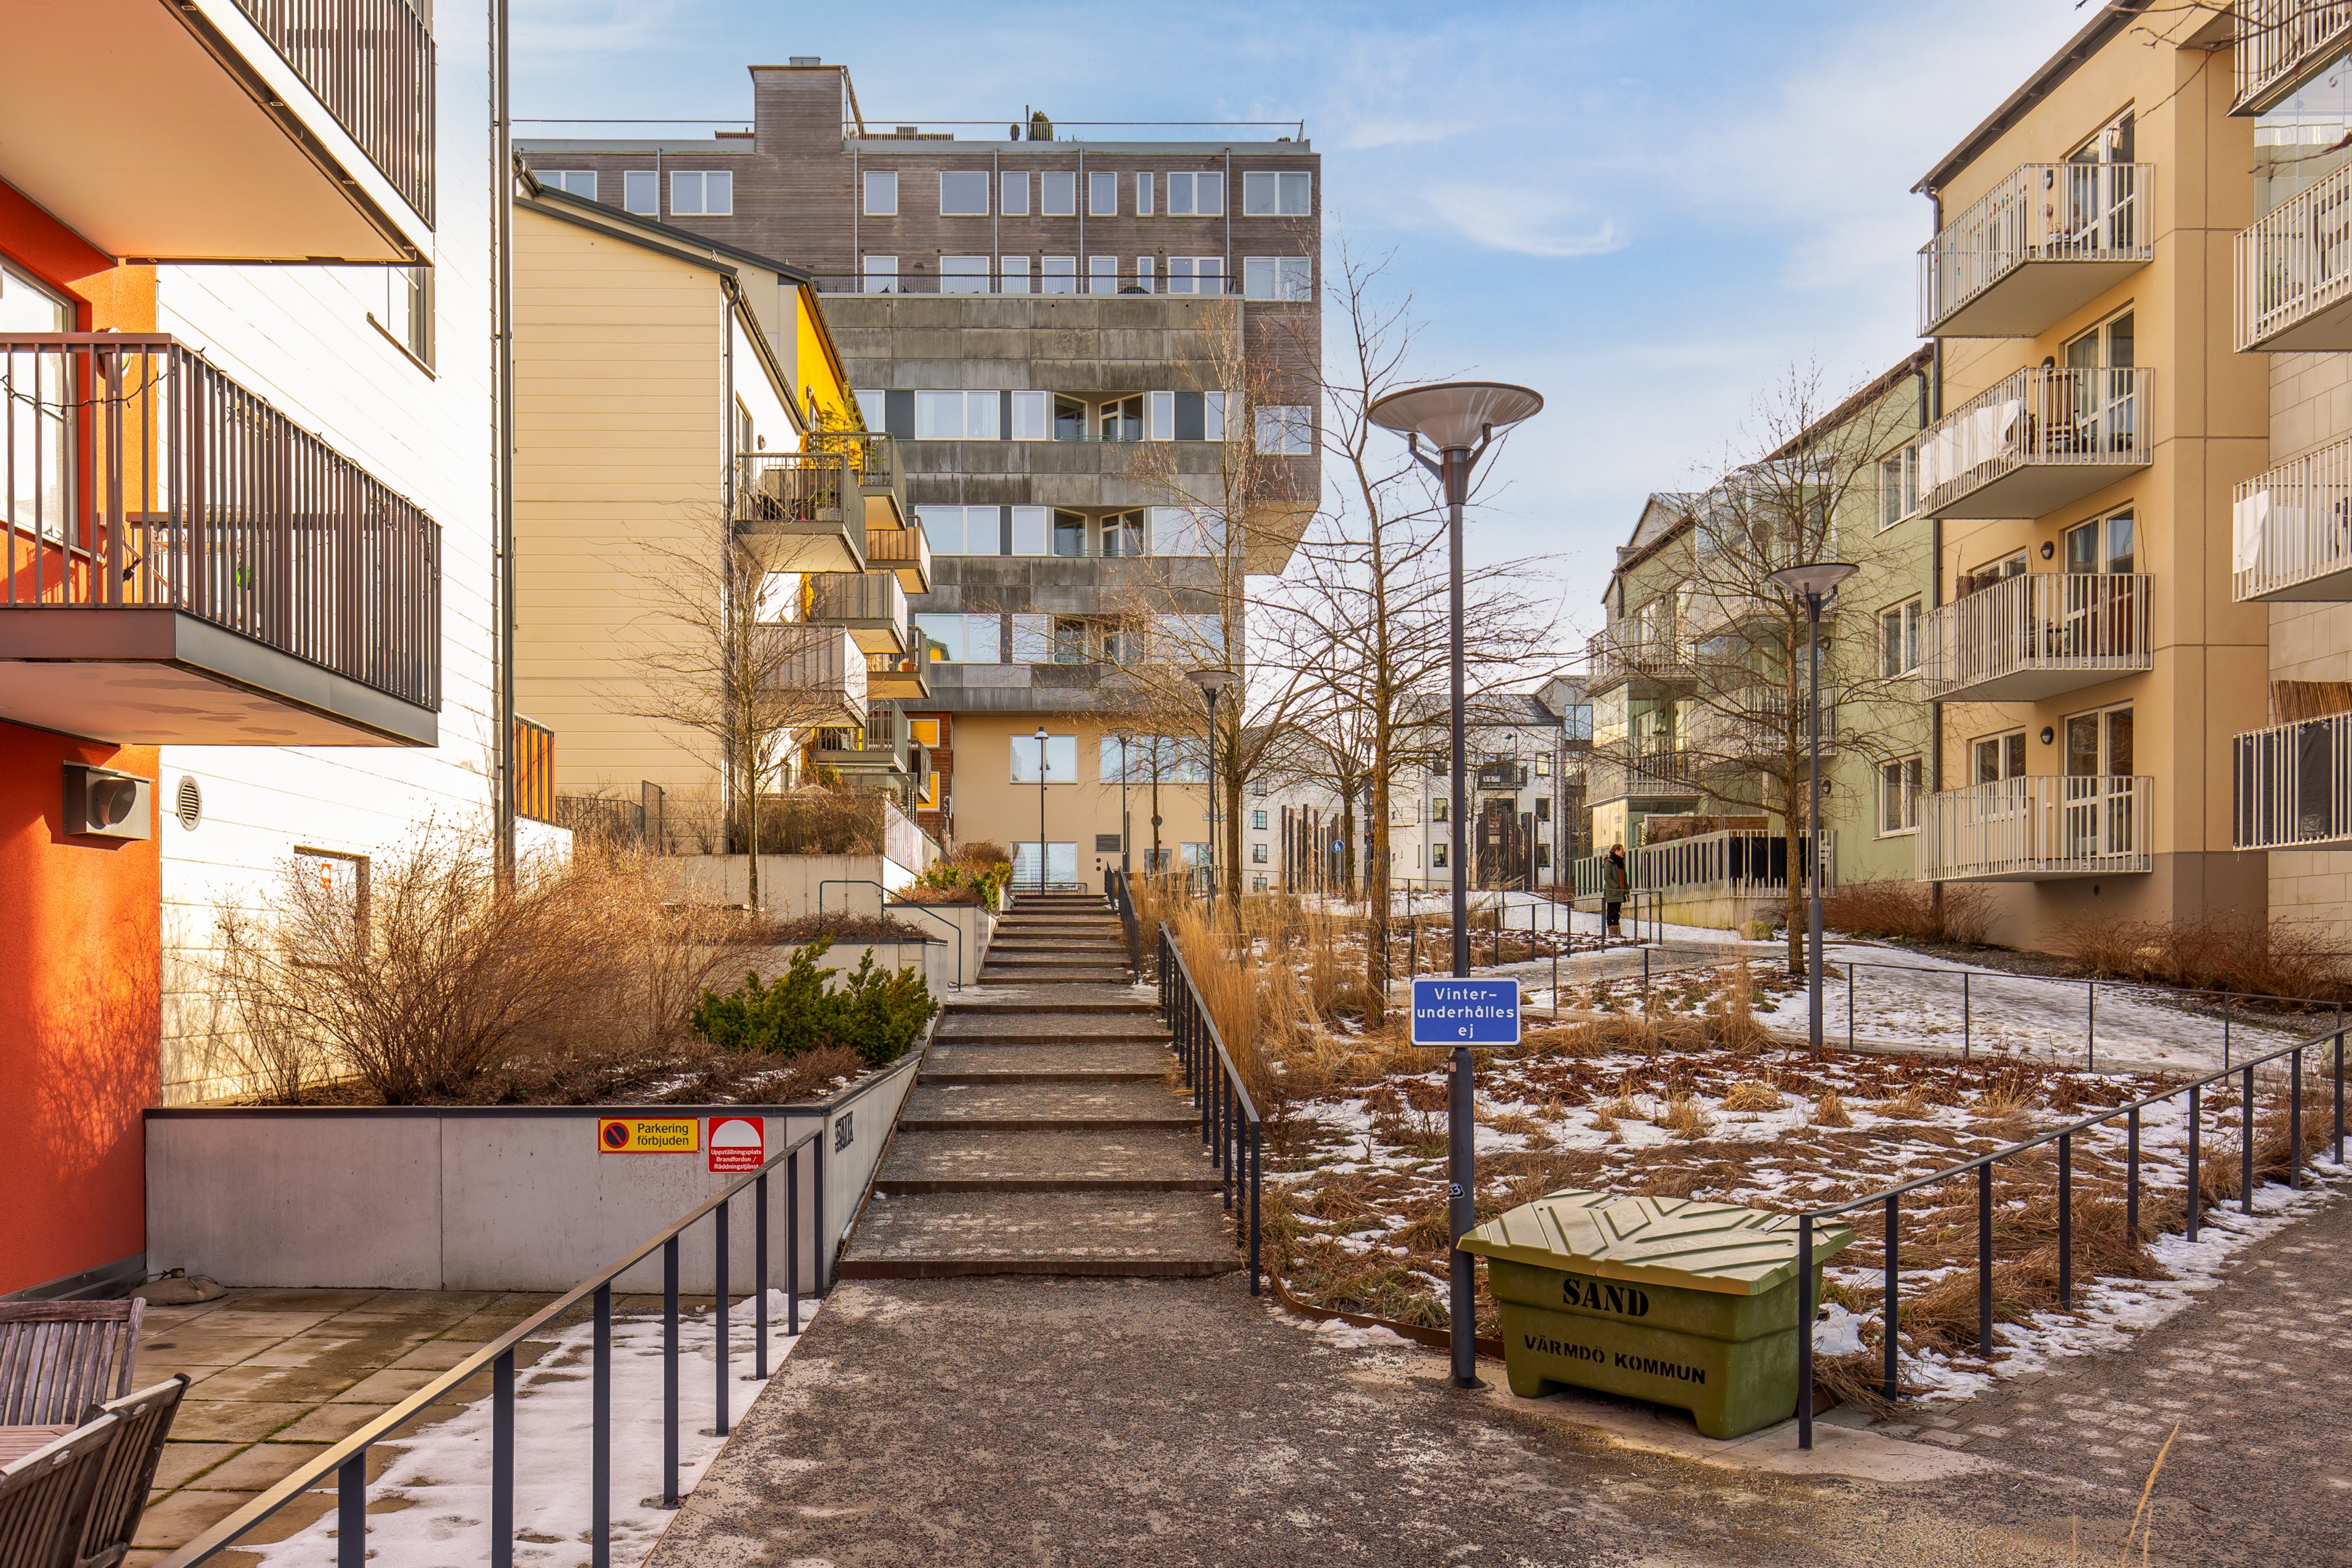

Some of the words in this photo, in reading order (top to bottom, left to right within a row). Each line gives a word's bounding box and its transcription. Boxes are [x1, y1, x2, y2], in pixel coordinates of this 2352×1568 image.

[1434, 987, 1498, 1000] Vinter-
[1416, 1005, 1515, 1018] underhålles
[1458, 1024, 1474, 1040] ej
[637, 1123, 689, 1136] Parkering
[637, 1135, 690, 1148] förbjuden
[1563, 1278, 1649, 1318] SAND
[1524, 1335, 1606, 1364] VÄRMDÖ
[1614, 1352, 1705, 1384] KOMMUN
